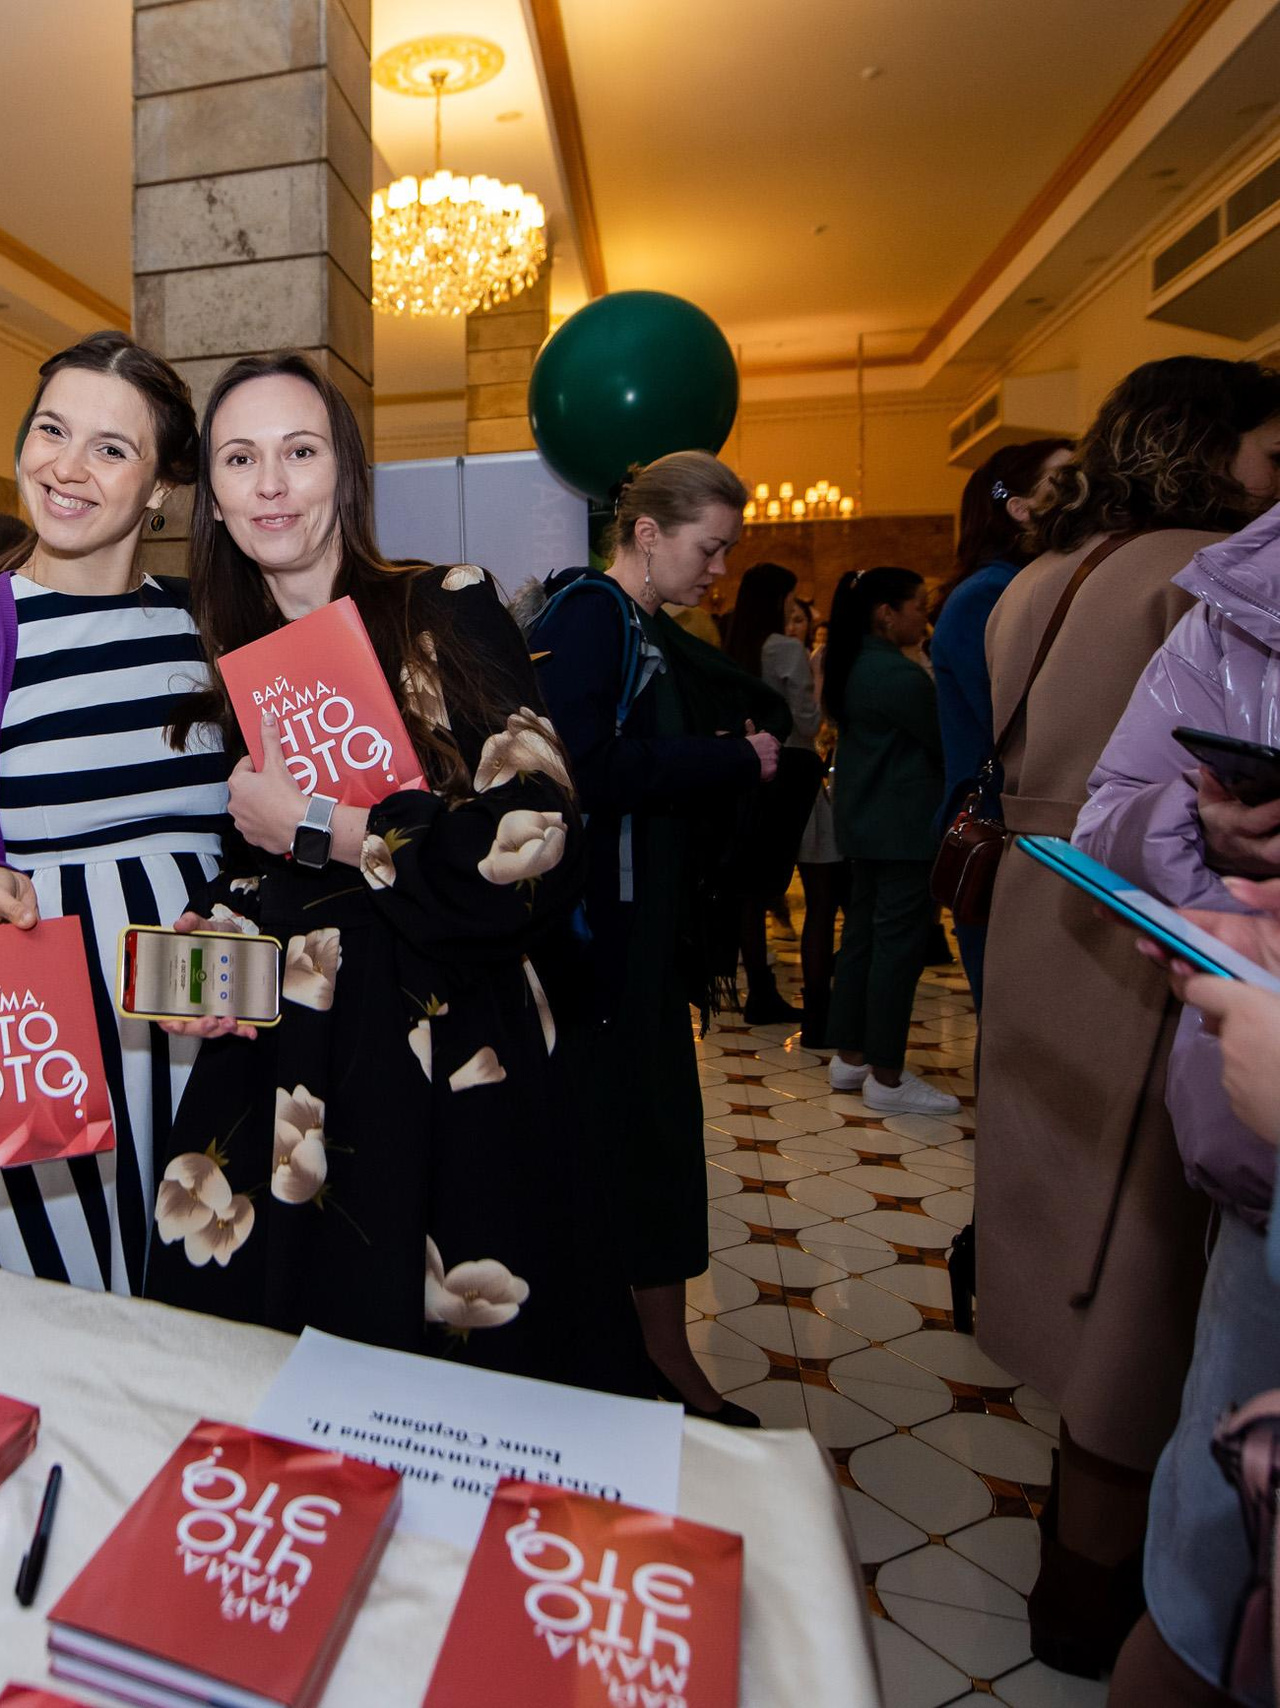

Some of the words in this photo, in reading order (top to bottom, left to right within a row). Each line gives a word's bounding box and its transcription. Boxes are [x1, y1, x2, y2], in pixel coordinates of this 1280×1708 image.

[252, 675, 294, 706] ВАЙ,
[285, 725, 395, 796] ЭТО?
[369, 1410, 488, 1446] Сбербанк
[498, 1438, 562, 1466] Банк
[182, 1446, 342, 1545] ЭТО?
[175, 1543, 302, 1608] МАМА,
[176, 1508, 312, 1588] ЧТО
[505, 1507, 695, 1620] ЭТО?
[220, 1582, 289, 1633] ВАЙ,
[524, 1580, 691, 1669] ЧТО
[534, 1623, 689, 1696] МАМА,
